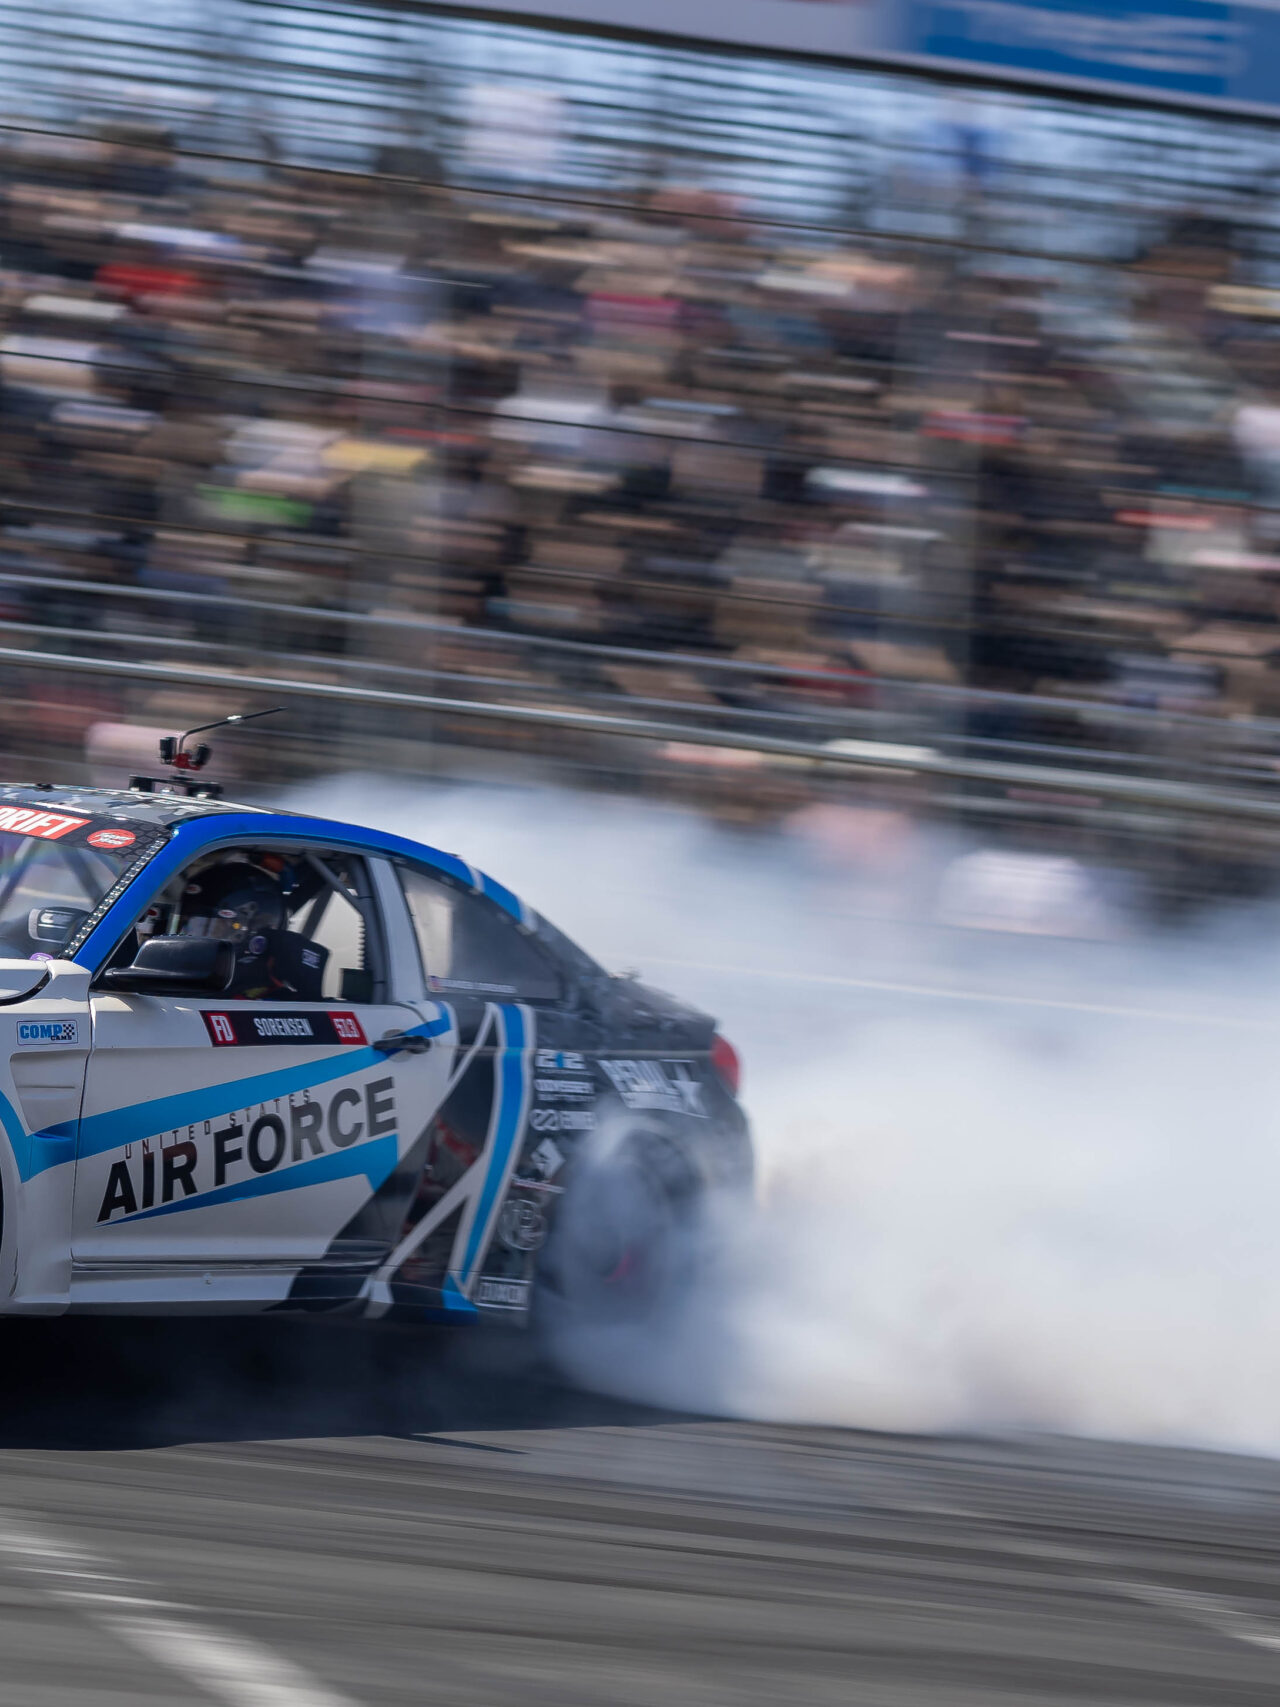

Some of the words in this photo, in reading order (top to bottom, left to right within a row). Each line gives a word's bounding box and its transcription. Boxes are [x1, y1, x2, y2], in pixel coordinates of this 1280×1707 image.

[19, 1023, 63, 1040] COMP
[210, 1015, 235, 1042] FD
[253, 1017, 315, 1037] SORENSEN
[125, 1119, 211, 1160] UNITED
[228, 1088, 312, 1128] STATES
[96, 1141, 198, 1224] AIR
[213, 1076, 397, 1187] FORCE
